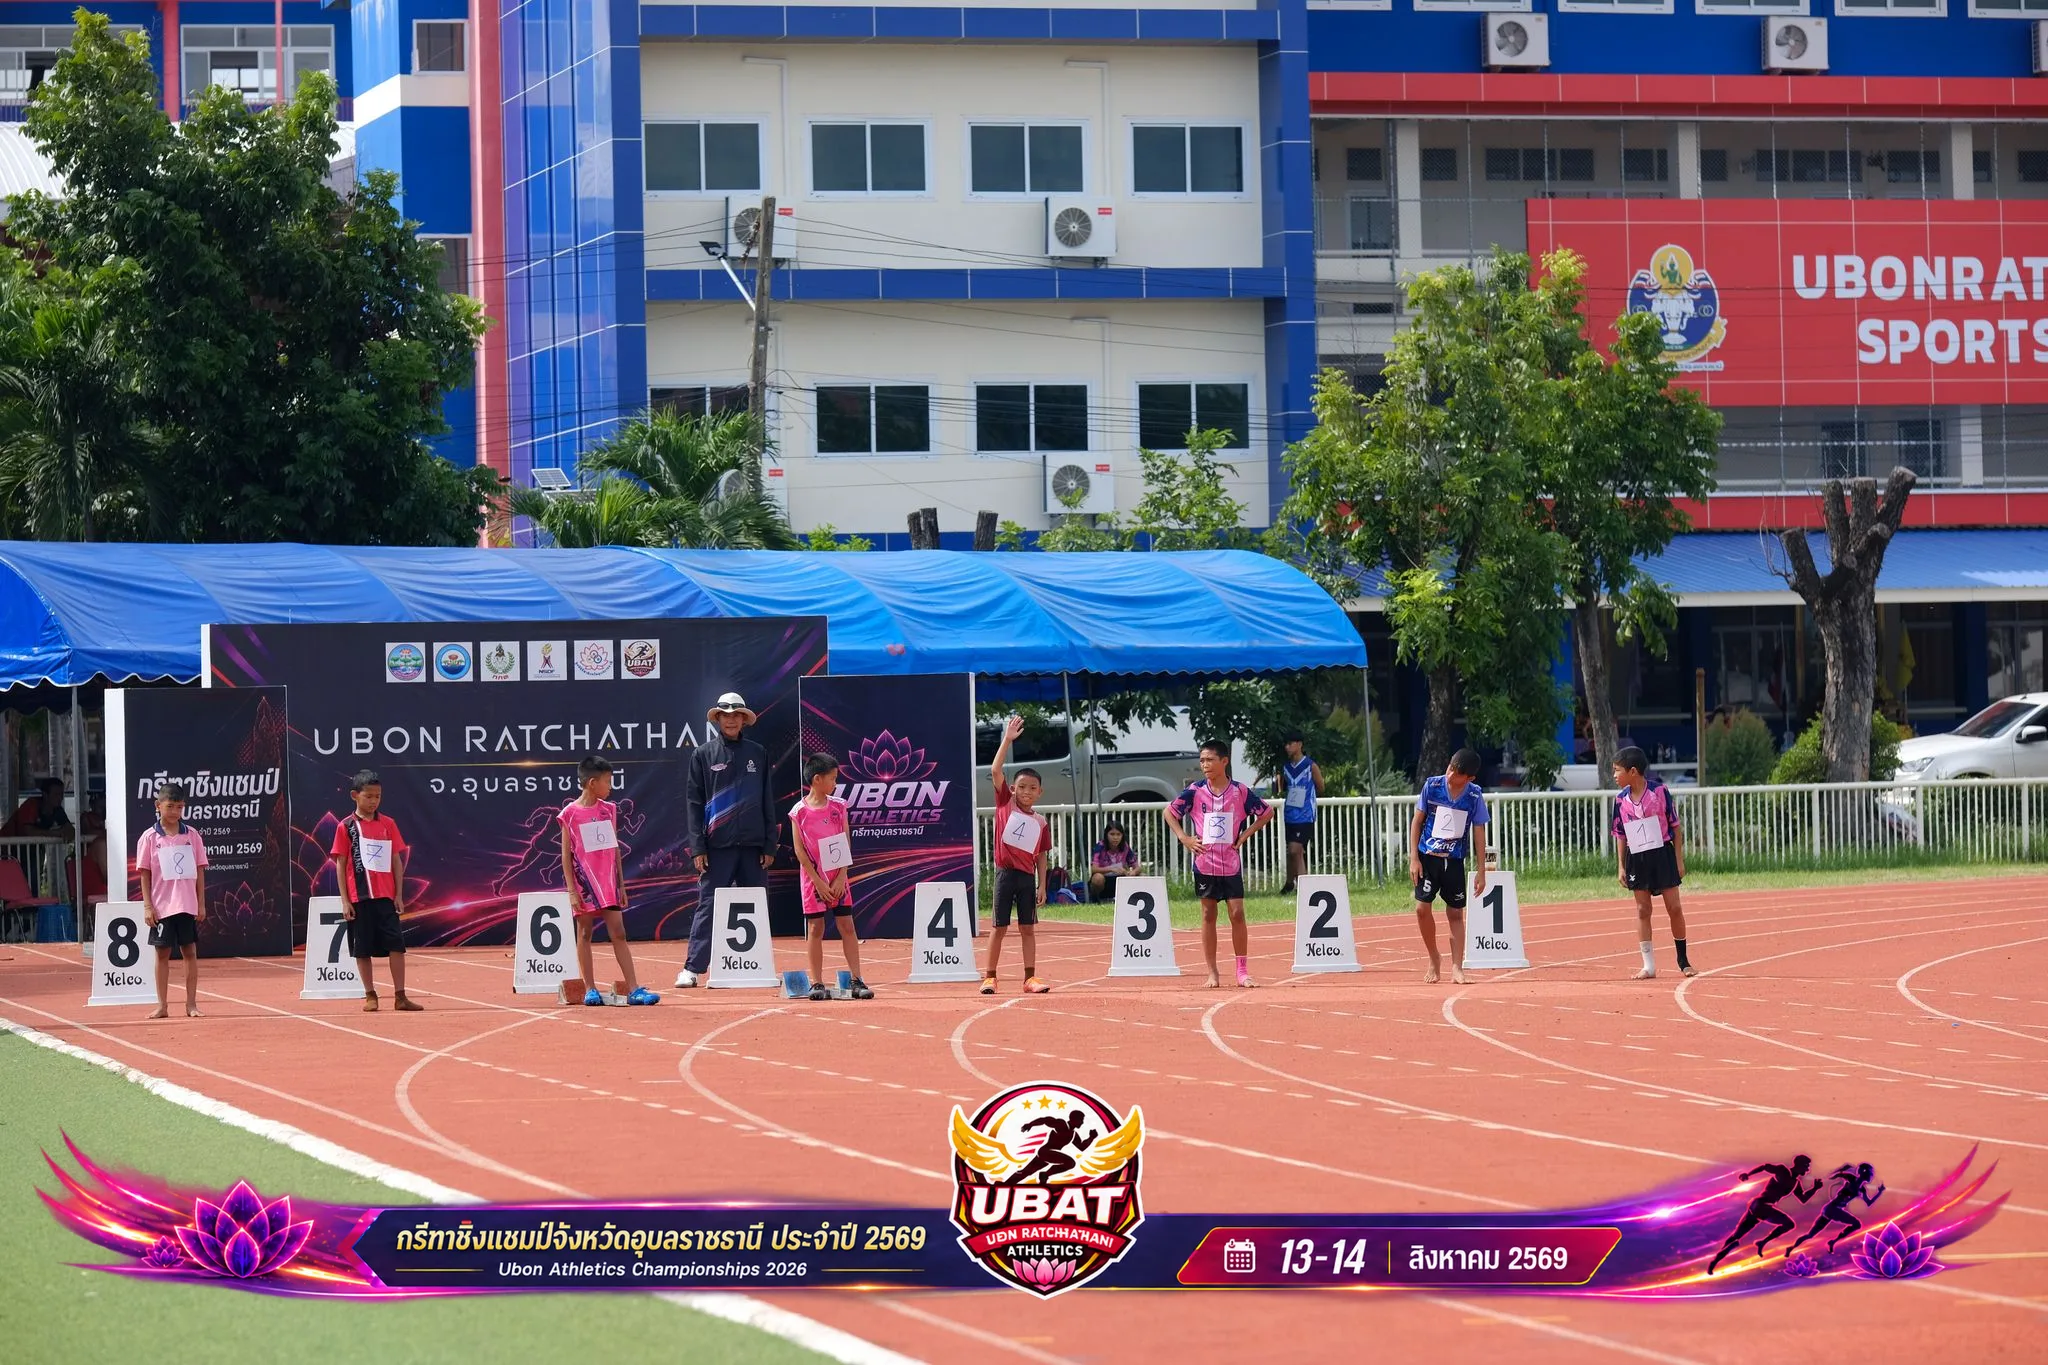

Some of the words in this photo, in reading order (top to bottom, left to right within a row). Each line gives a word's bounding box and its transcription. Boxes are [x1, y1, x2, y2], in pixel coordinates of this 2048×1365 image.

[627, 659, 654, 667] UBAT
[314, 726, 442, 755] UBON
[465, 721, 719, 752] RATCHATHAN
[429, 768, 625, 801] จ.อุบลราชนี
[834, 780, 951, 808] UBON
[848, 808, 945, 824] THLETICS
[1440, 814, 1453, 832] 2
[213, 827, 231, 836] 2569
[596, 826, 606, 843] 6
[1012, 821, 1026, 841] 4
[1209, 815, 1226, 838] 3
[236, 842, 263, 854] 2569
[366, 843, 383, 863] 7
[828, 842, 842, 864] 5
[173, 852, 185, 875] 8
[1422, 879, 1432, 893] 5
[1127, 891, 1157, 940] 3
[1308, 890, 1339, 939] 2
[1482, 884, 1504, 934] 1
[530, 905, 562, 956] 6
[725, 902, 757, 953] 5
[927, 898, 958, 947] 4
[107, 917, 140, 968] 8
[319, 912, 349, 964] 7
[1475, 936, 1509, 950] Nelco
[923, 950, 960, 965] Nelco
[1305, 942, 1341, 957] Nelco
[526, 959, 563, 974] Nelco
[721, 955, 759, 970] Nelco
[104, 972, 142, 987] Nelco
[316, 967, 355, 981] Nelco
